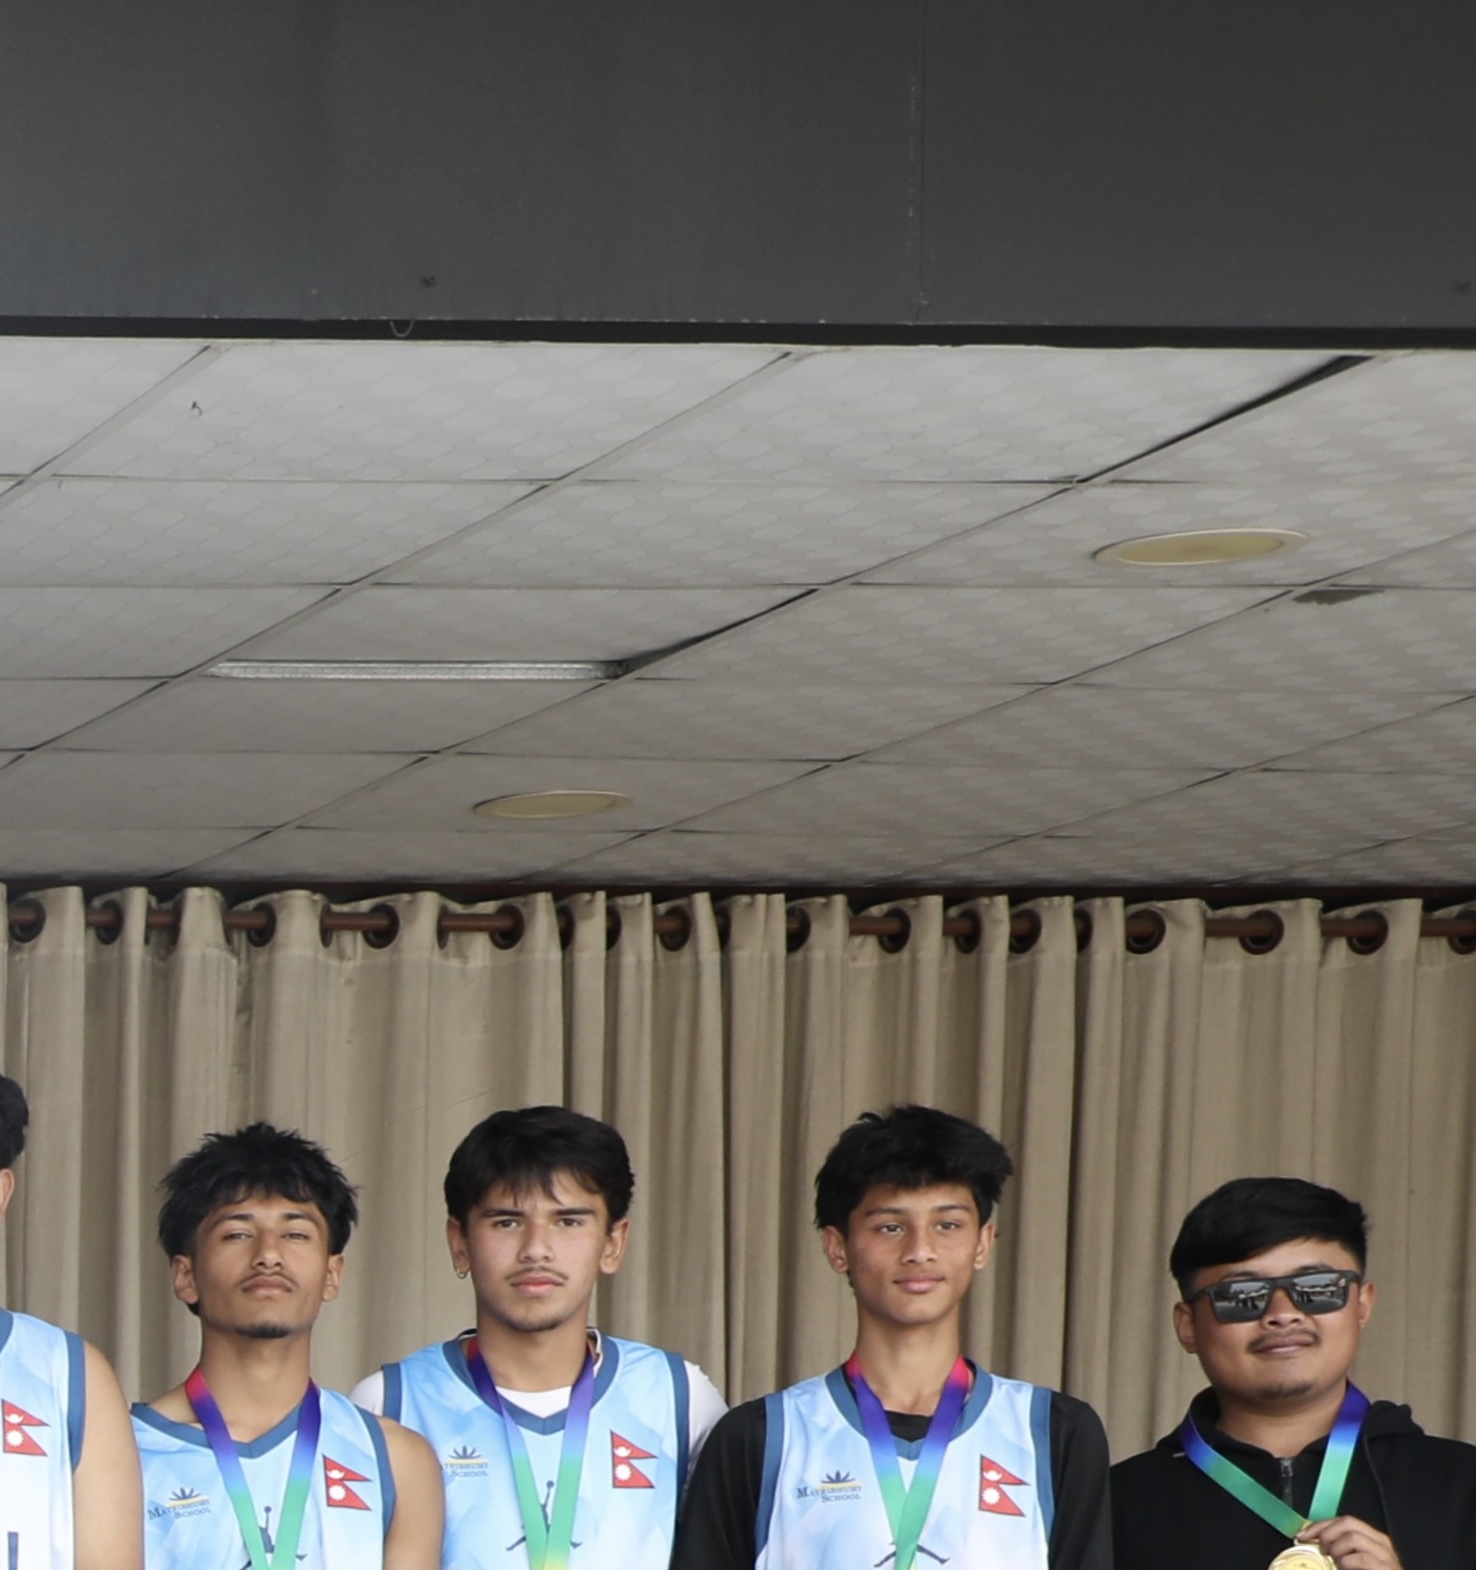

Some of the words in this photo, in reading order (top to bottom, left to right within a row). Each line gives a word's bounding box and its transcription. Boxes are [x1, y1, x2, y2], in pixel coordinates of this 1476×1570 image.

[450, 1469, 489, 1478] SCHOOL
[820, 1490, 862, 1503] SCHOOL
[174, 1509, 212, 1520] SCHOOL
